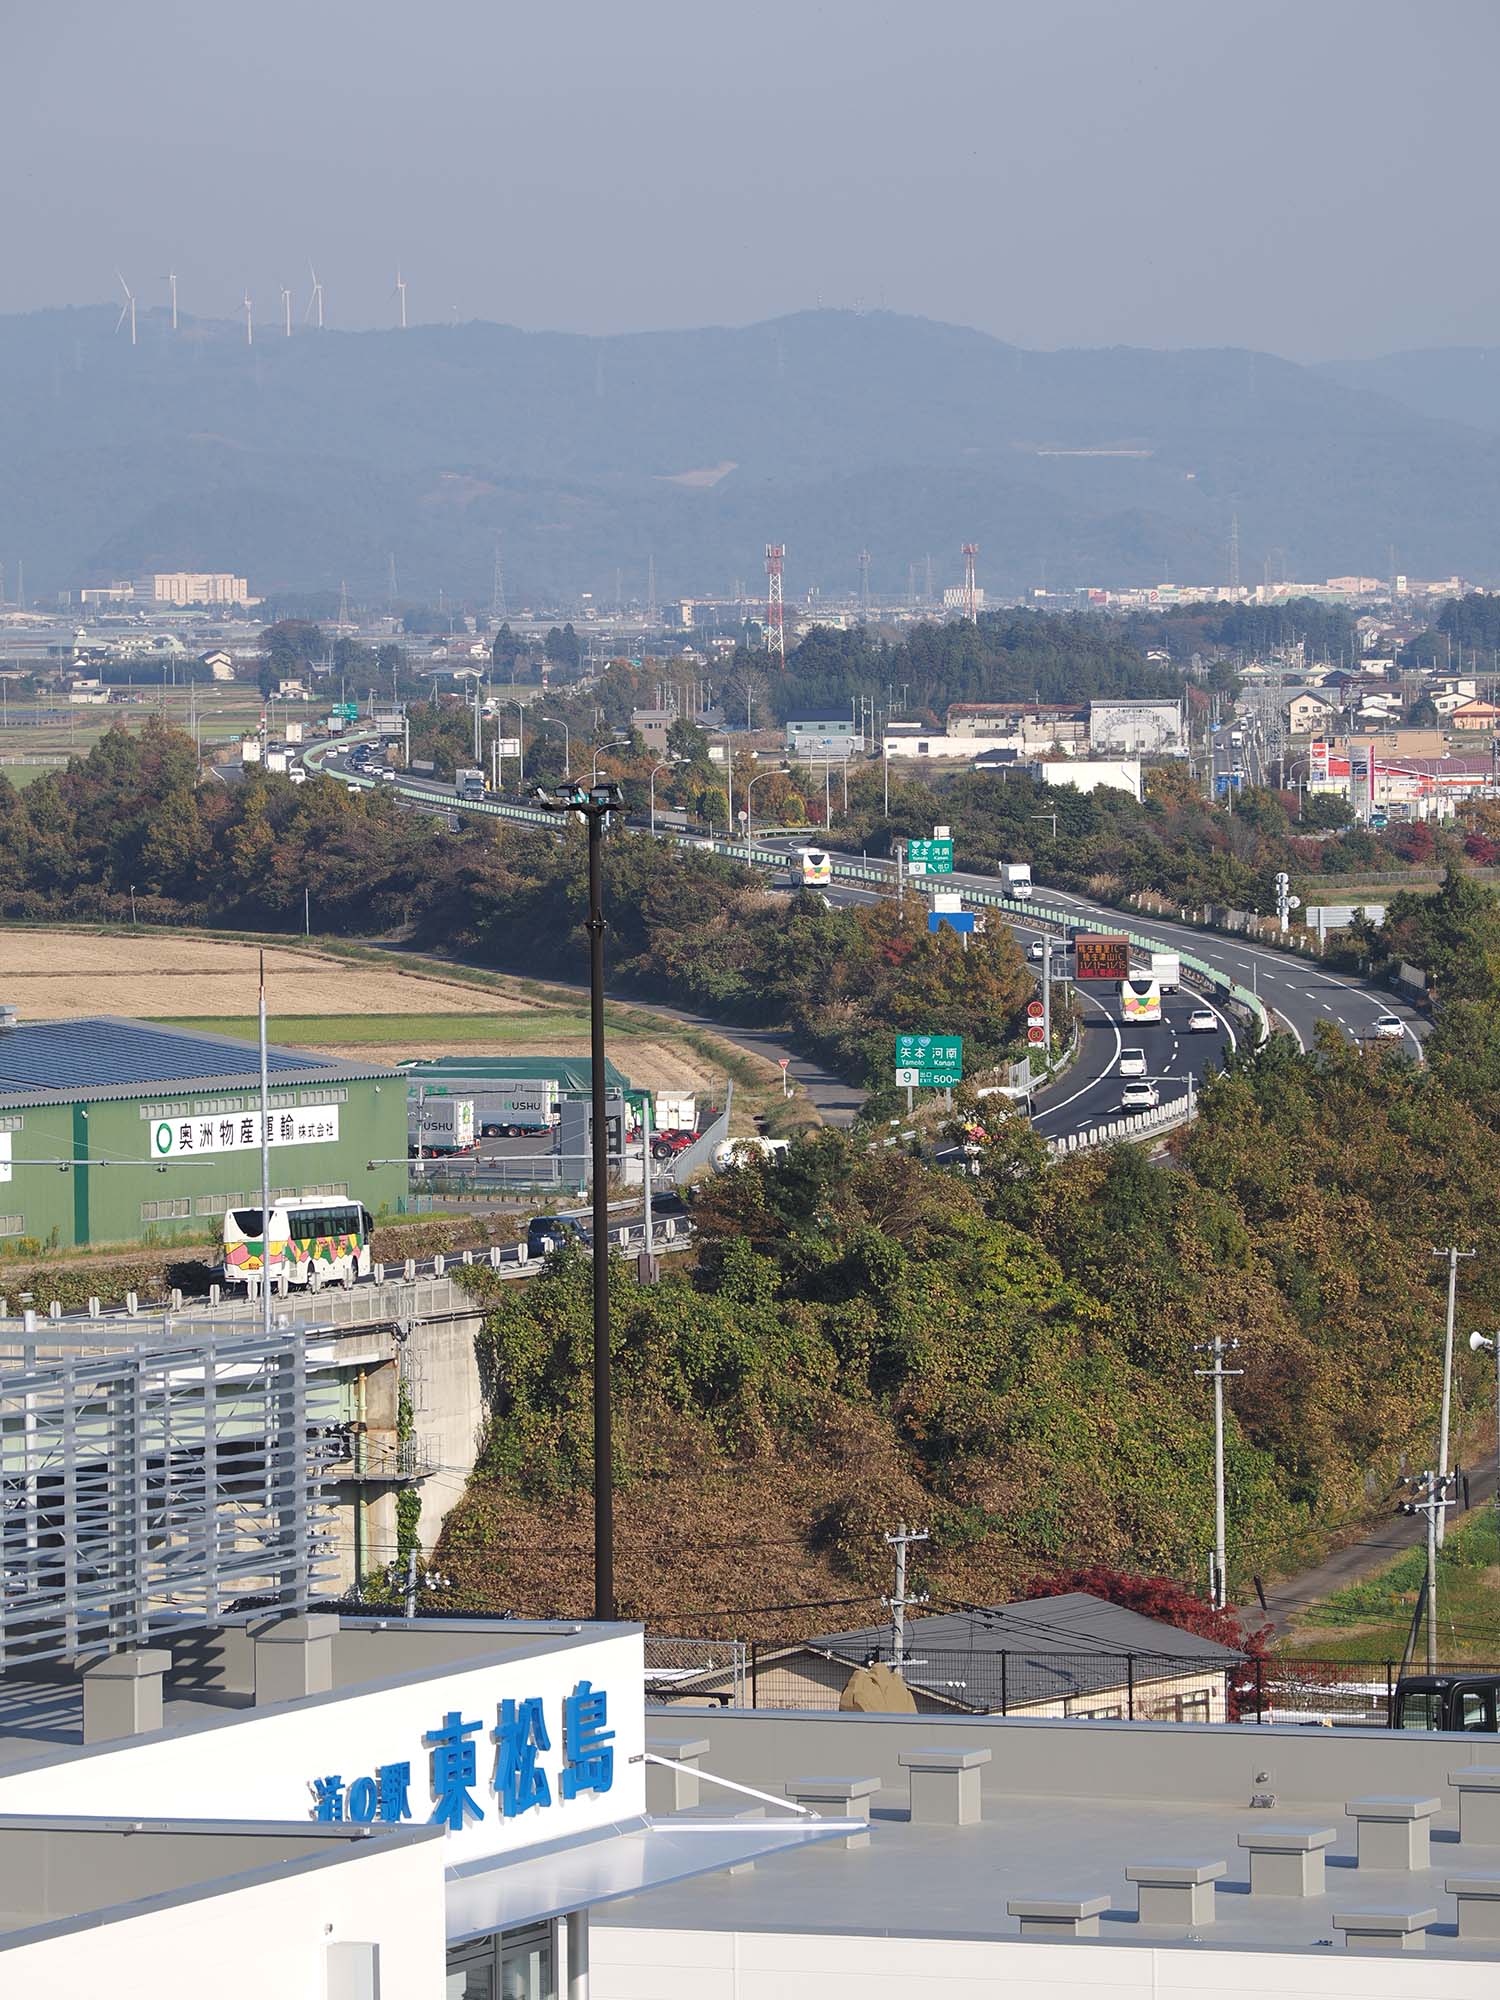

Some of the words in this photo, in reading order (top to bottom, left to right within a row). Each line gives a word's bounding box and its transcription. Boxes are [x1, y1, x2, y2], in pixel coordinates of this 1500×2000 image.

[914, 863, 921, 872] 9
[900, 1047, 926, 1058] 矢本
[931, 1047, 958, 1059] 河南
[903, 1071, 912, 1083] 9
[298, 1121, 334, 1139] 株式会社
[426, 1680, 616, 1831] 東松島
